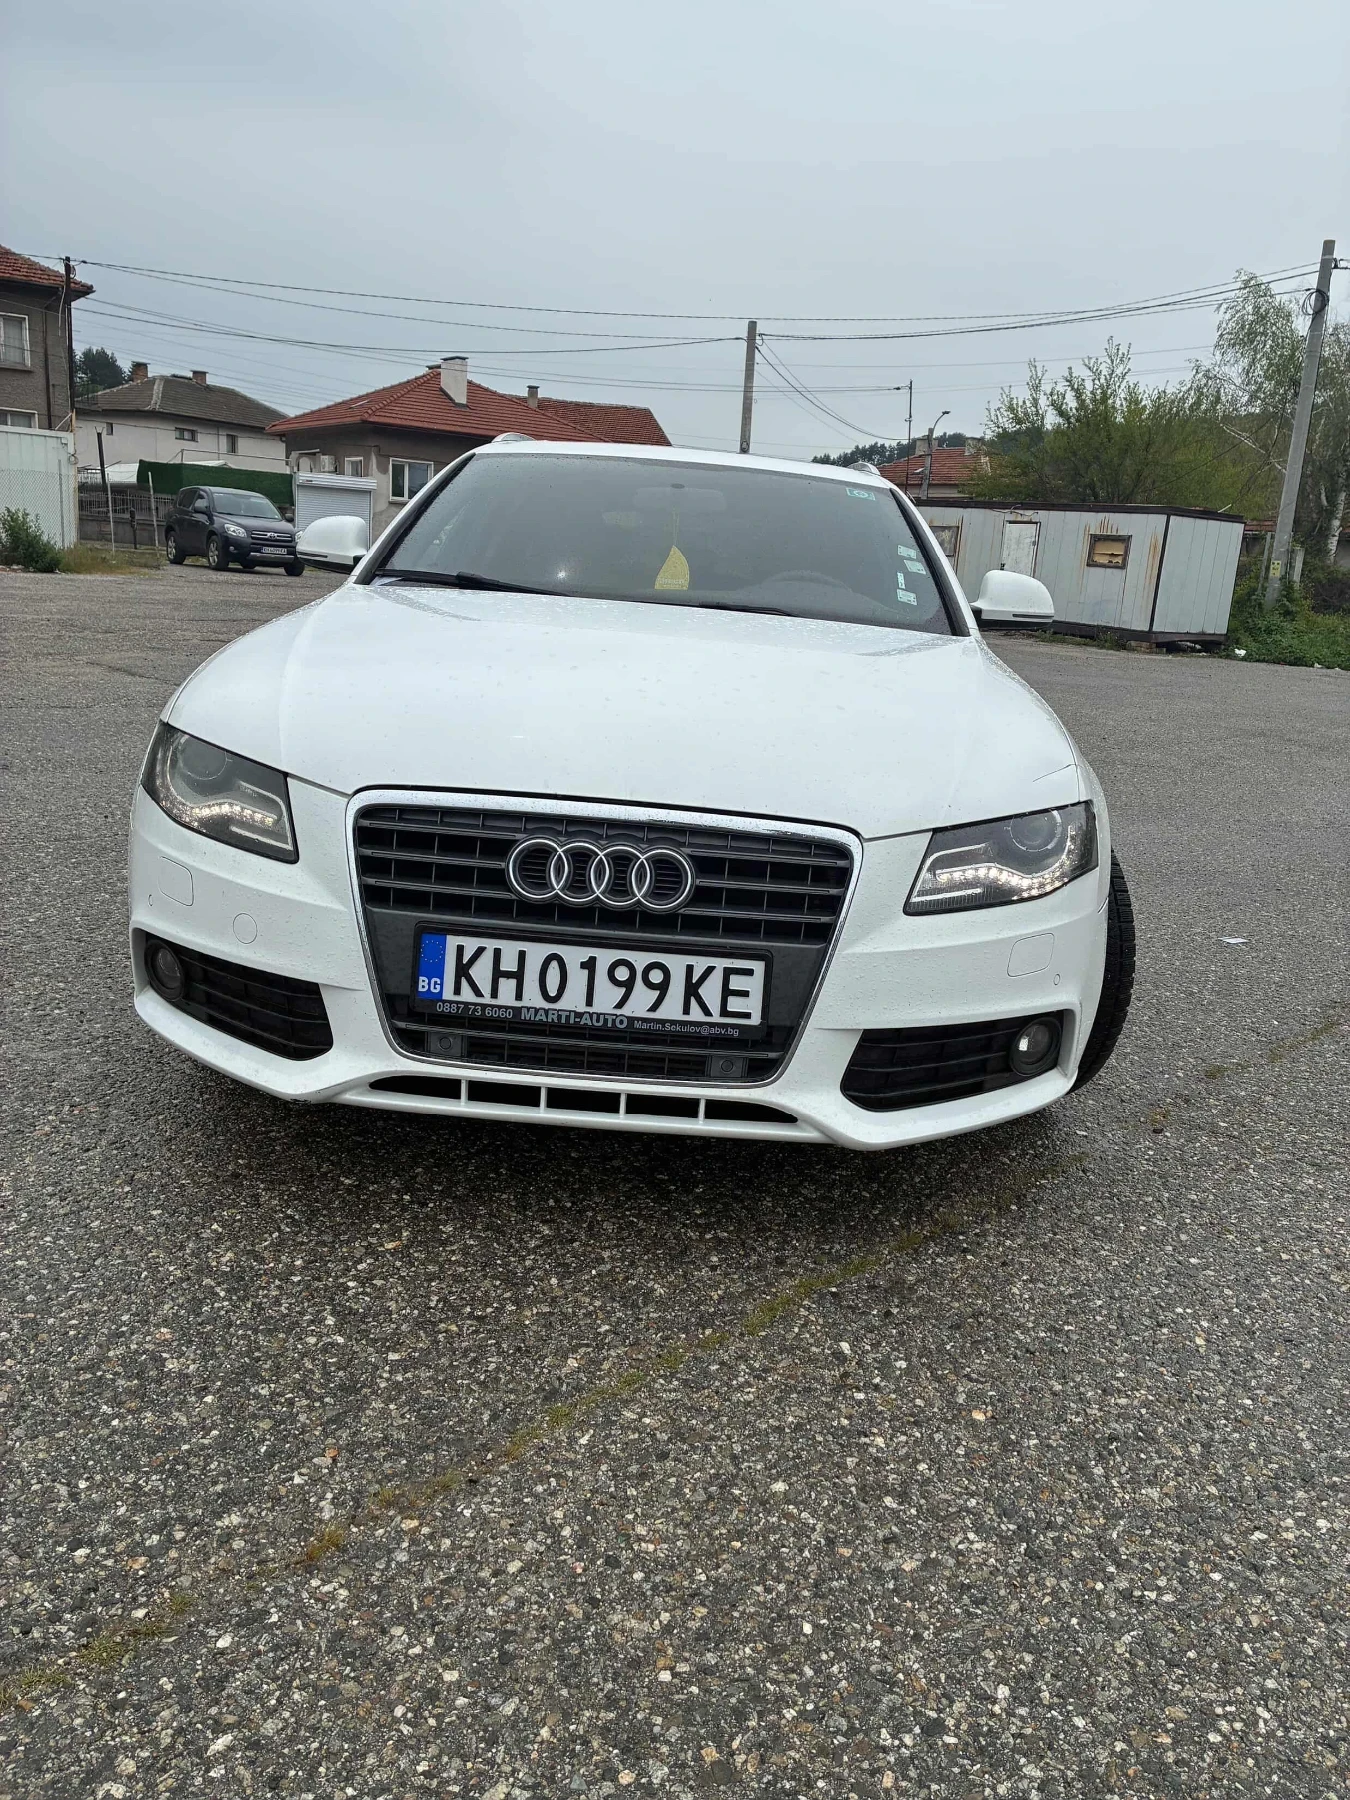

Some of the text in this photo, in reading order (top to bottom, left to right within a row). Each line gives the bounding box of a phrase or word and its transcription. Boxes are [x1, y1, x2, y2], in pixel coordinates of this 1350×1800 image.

[418, 976, 441, 993] BG
[436, 1001, 739, 1036] 0887 73 6060 MARTI-AUTO Martin.Sekulov@abv.bg
